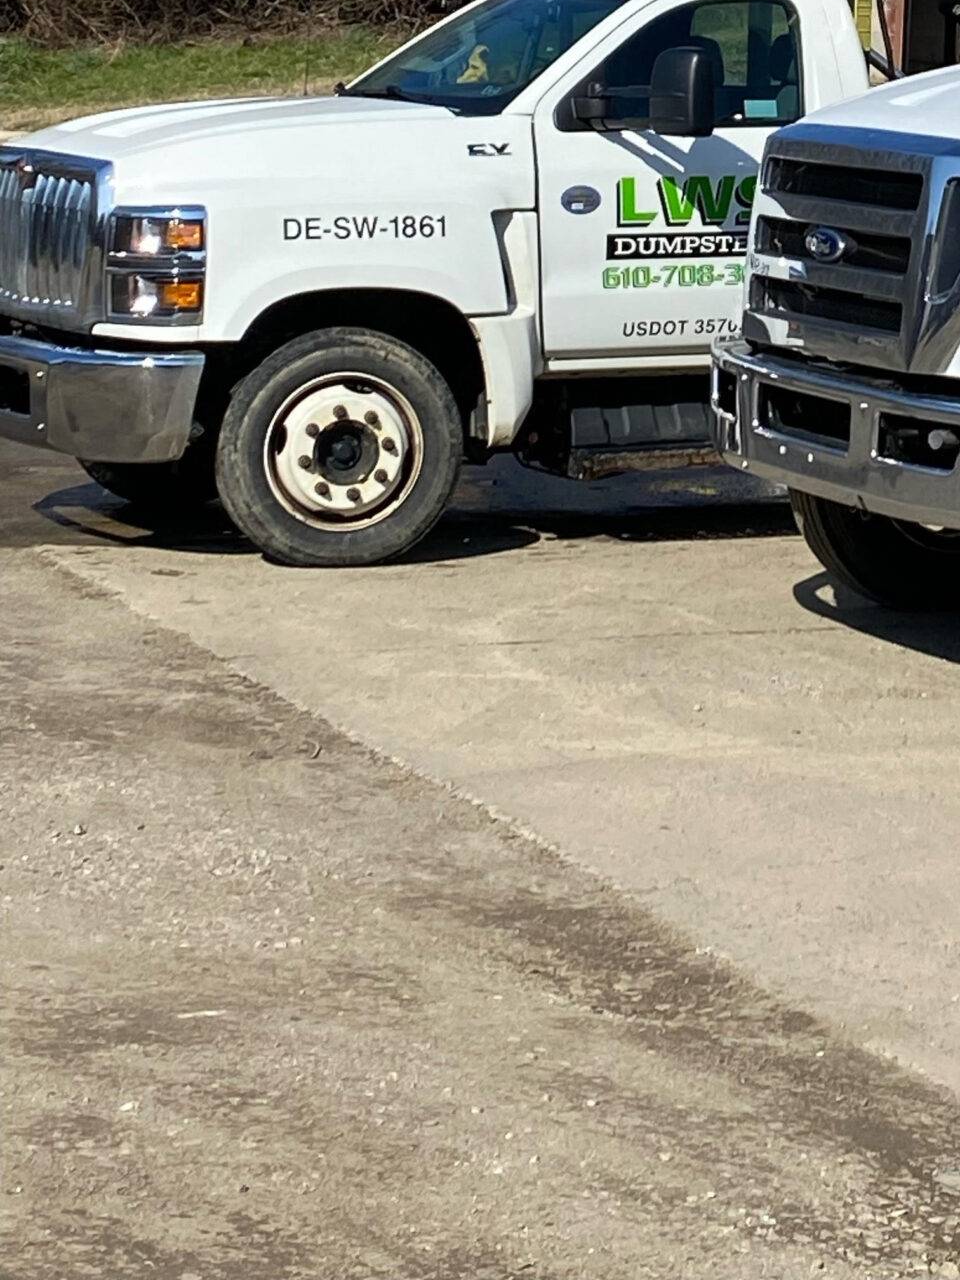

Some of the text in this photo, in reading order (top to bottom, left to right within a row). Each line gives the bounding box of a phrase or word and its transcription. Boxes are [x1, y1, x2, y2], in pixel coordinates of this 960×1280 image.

[283, 215, 447, 240] DE-SW-1861
[623, 318, 743, 337] USDOT 3570
